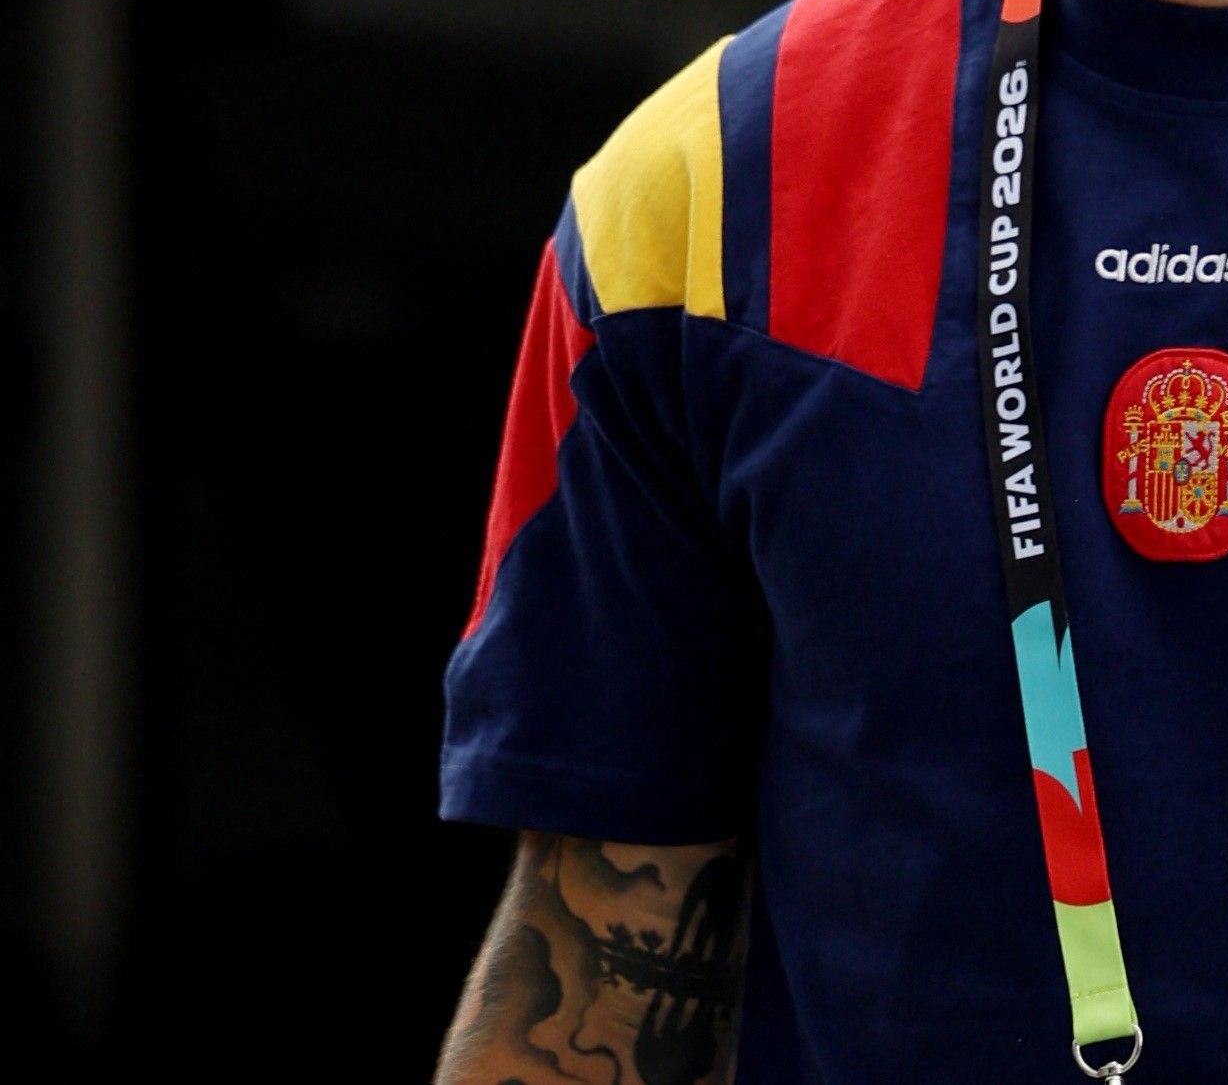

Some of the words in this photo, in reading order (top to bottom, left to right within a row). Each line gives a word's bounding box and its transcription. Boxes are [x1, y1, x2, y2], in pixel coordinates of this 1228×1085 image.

[991, 67, 1029, 208] 2026
[988, 215, 1019, 296] CUP
[990, 303, 1032, 462] WORLD
[1004, 463, 1045, 560] FIFA
